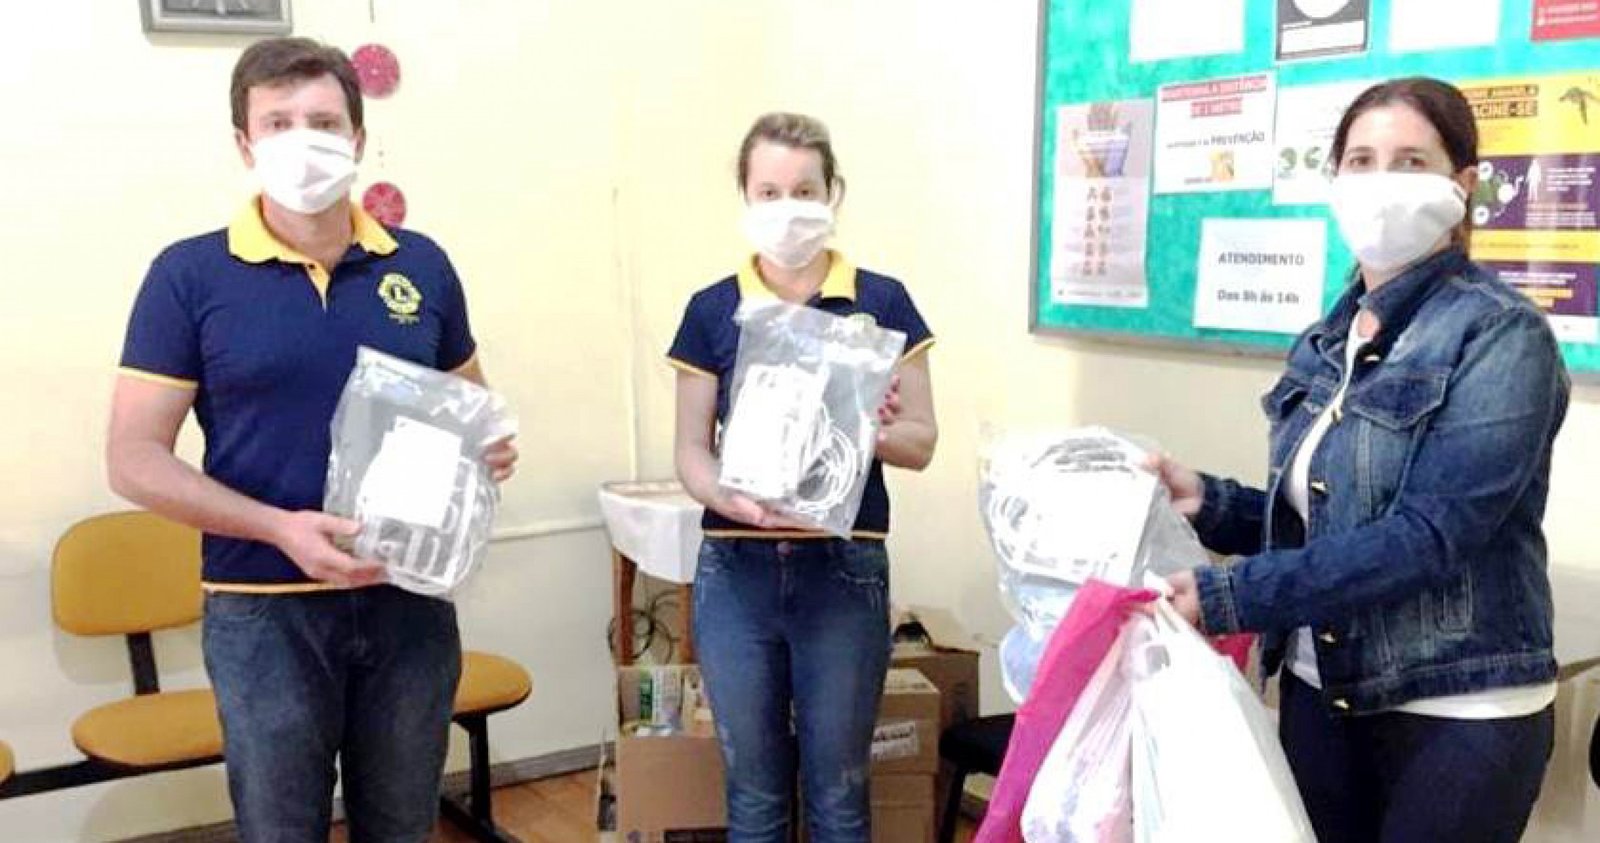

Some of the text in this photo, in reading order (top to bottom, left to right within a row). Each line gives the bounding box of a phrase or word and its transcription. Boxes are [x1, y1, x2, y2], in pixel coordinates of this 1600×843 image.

[1210, 130, 1264, 145] PREVENÇÃO
[1218, 251, 1305, 266] ATENDIMENTO
[1217, 290, 1240, 301] Das
[1243, 290, 1257, 302] 8h
[1278, 292, 1299, 304] 14h
